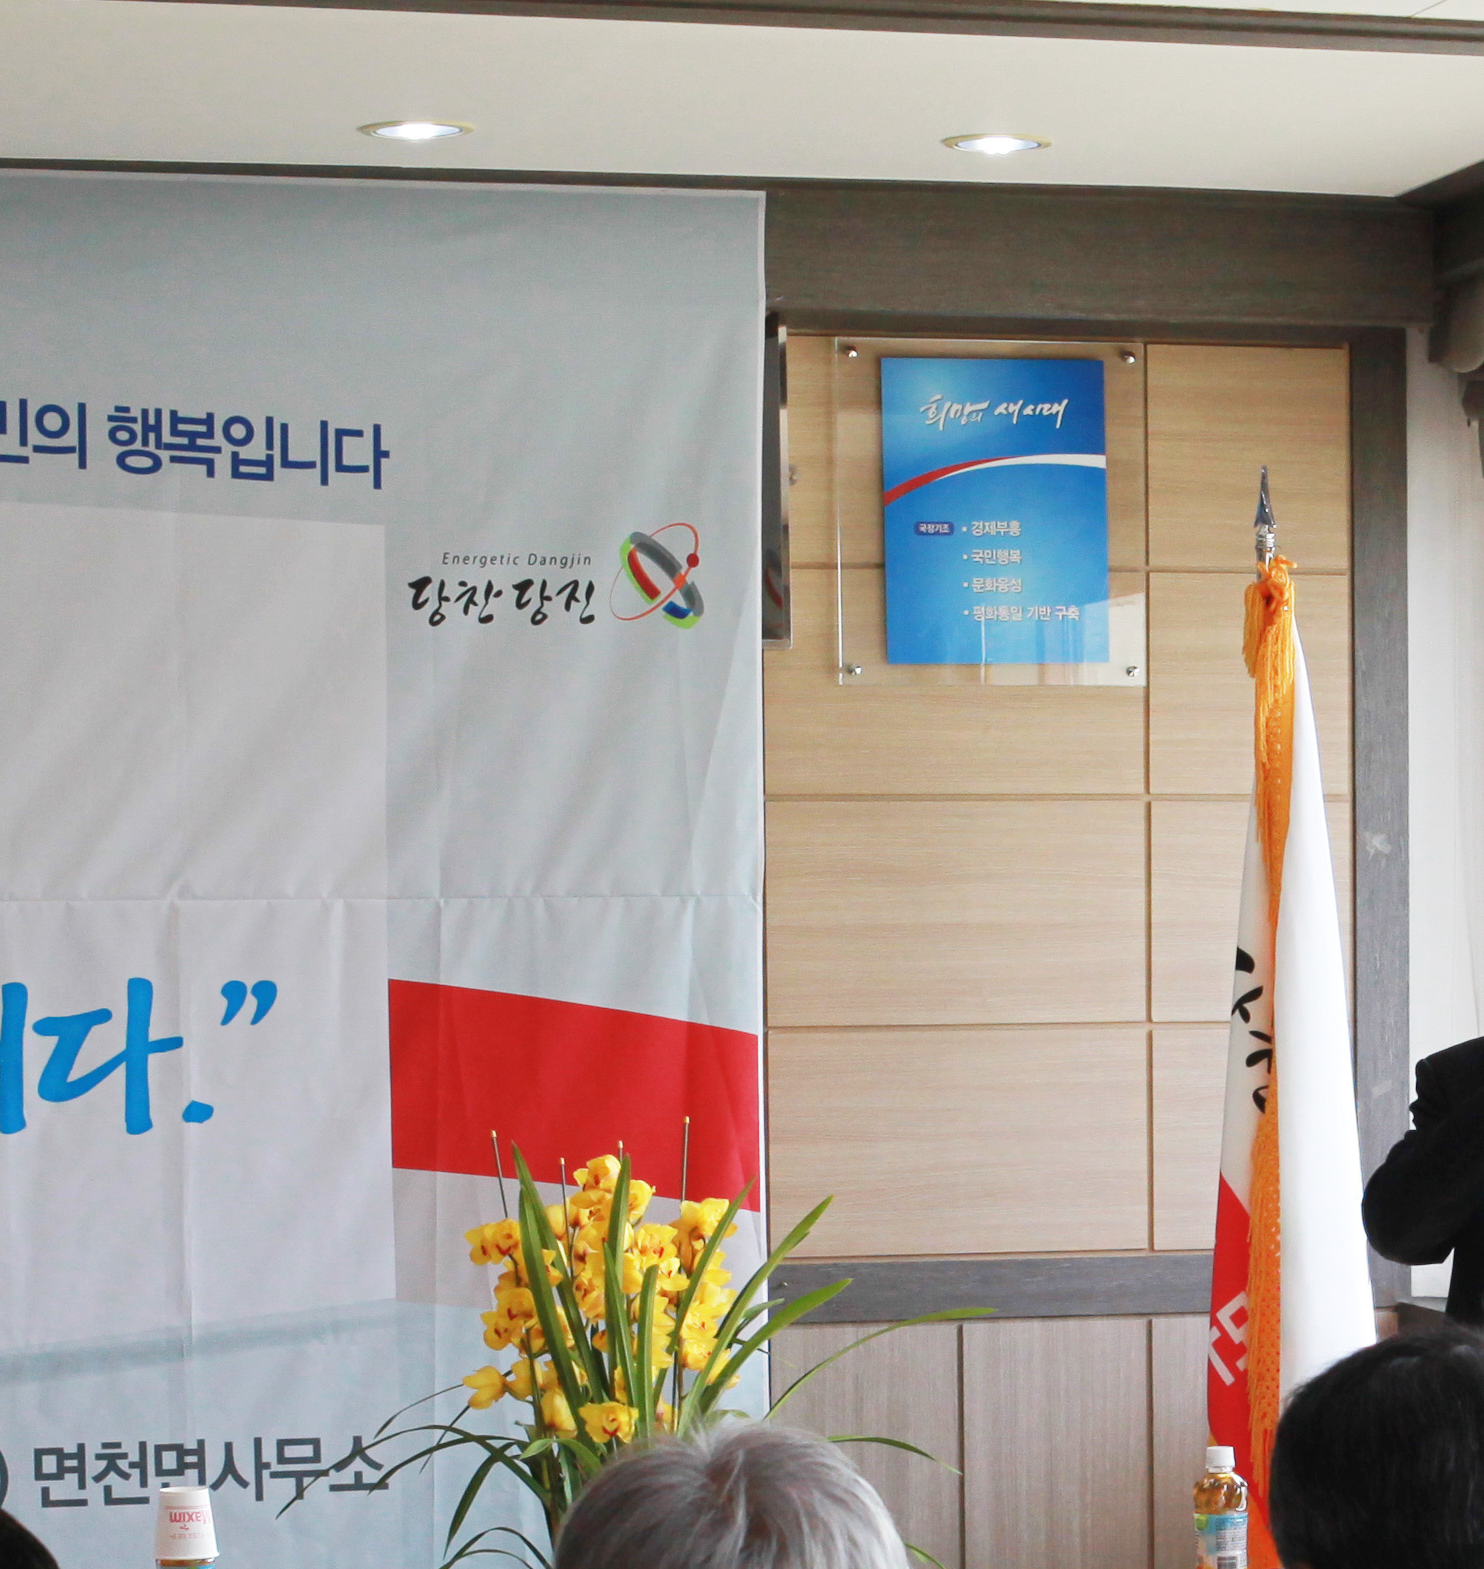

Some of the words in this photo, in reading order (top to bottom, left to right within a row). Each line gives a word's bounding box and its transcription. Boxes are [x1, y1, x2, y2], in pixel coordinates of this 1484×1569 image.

[919, 394, 991, 431] 희망의
[106, 404, 392, 491] 행복입니다
[971, 520, 1022, 537] 경제부흥
[442, 552, 519, 568] Energetic
[527, 552, 592, 570] Dangjin
[971, 549, 1022, 565] 국민행복
[972, 577, 1023, 593] 문화융성
[973, 605, 1023, 622] 평화통일
[1027, 606, 1052, 621] 기반
[1055, 605, 1081, 621] 구축
[33, 1435, 390, 1509] 면천면사무소
